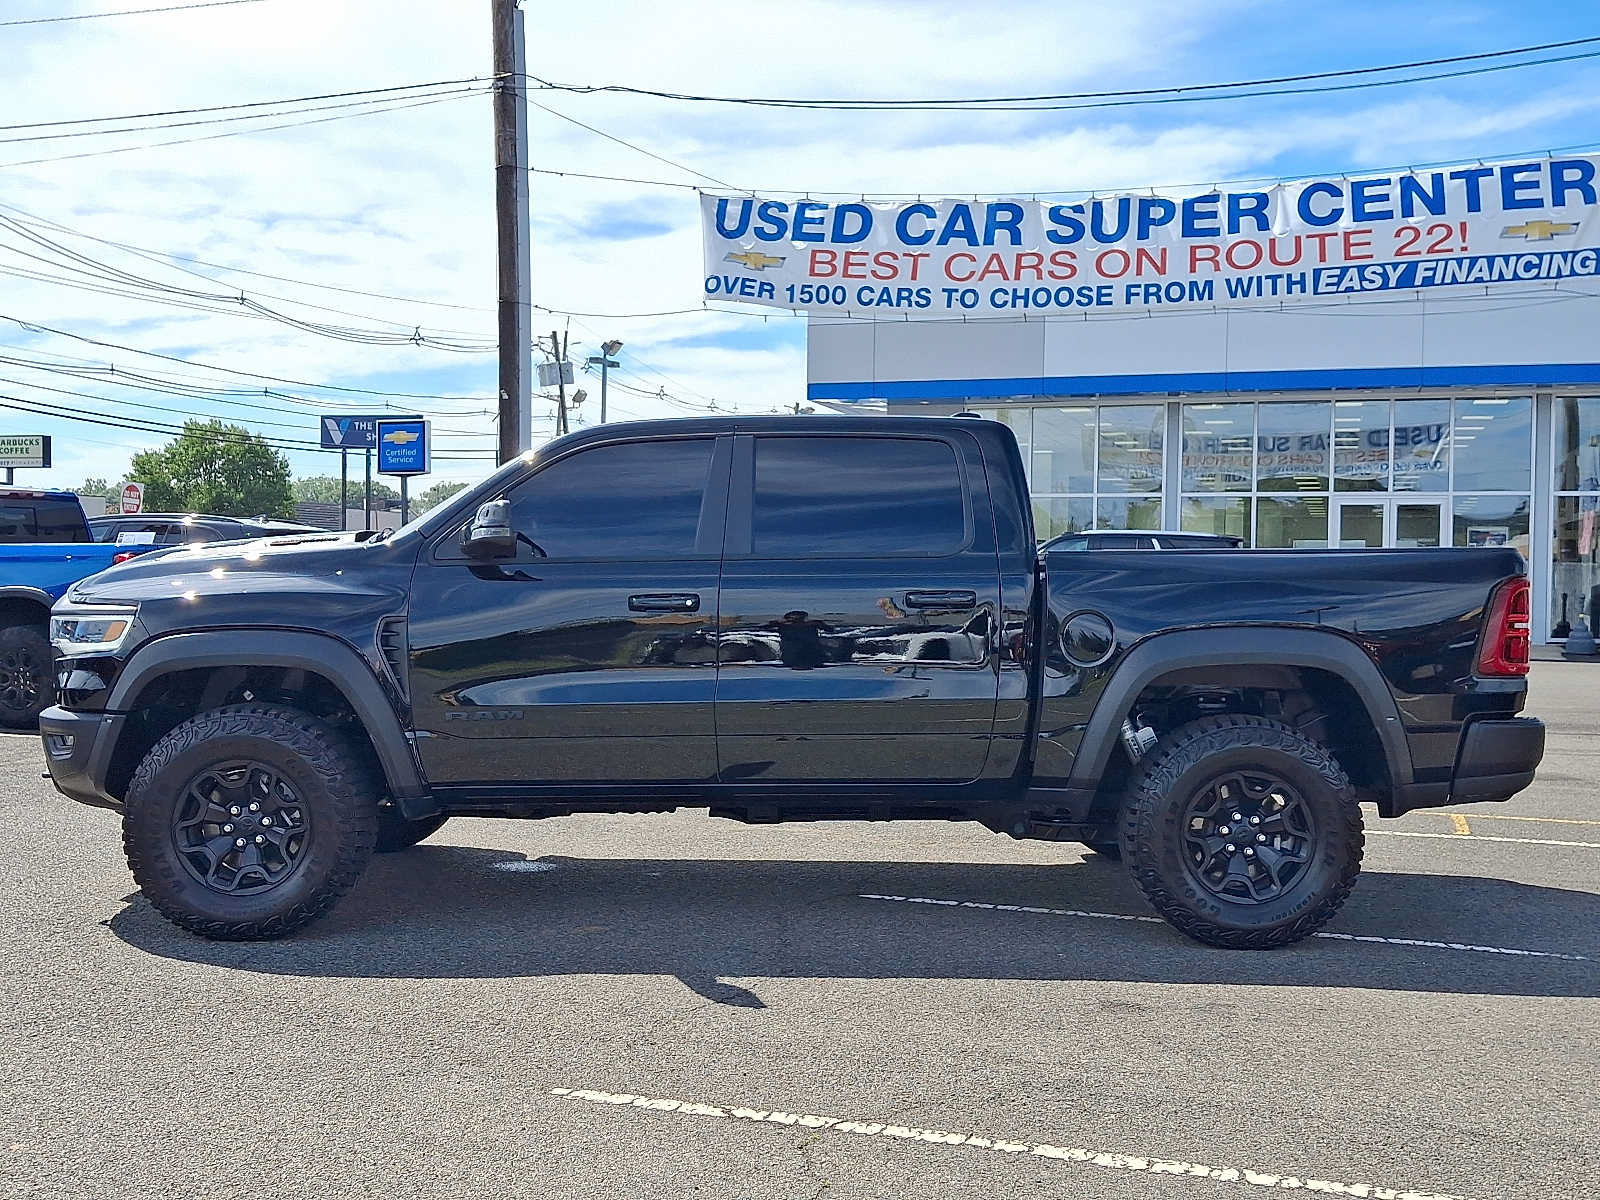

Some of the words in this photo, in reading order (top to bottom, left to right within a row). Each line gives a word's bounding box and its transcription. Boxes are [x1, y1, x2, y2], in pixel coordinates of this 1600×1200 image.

[715, 198, 874, 244] USED
[895, 202, 1026, 247] CAR
[1046, 191, 1271, 245] SUPER
[1297, 159, 1598, 227] CENTER
[808, 249, 931, 281] BEST
[944, 250, 1079, 283] CARS
[1094, 247, 1168, 279] ON
[1188, 228, 1374, 274] ROUTE
[1393, 221, 1470, 258] 22!
[704, 273, 776, 300] OVER
[785, 283, 847, 306] 1500
[855, 285, 933, 309] CARS
[940, 286, 980, 309] TO
[988, 284, 1115, 309] CHOOSE
[1124, 279, 1215, 305] FROM
[1223, 270, 1308, 299] WITH
[1317, 262, 1408, 294] EASY
[1413, 249, 1598, 287] FINANCING
[354, 421, 373, 431] THE
[385, 448, 417, 457] Certified
[388, 456, 414, 464] Service
[444, 710, 525, 721] RAM
